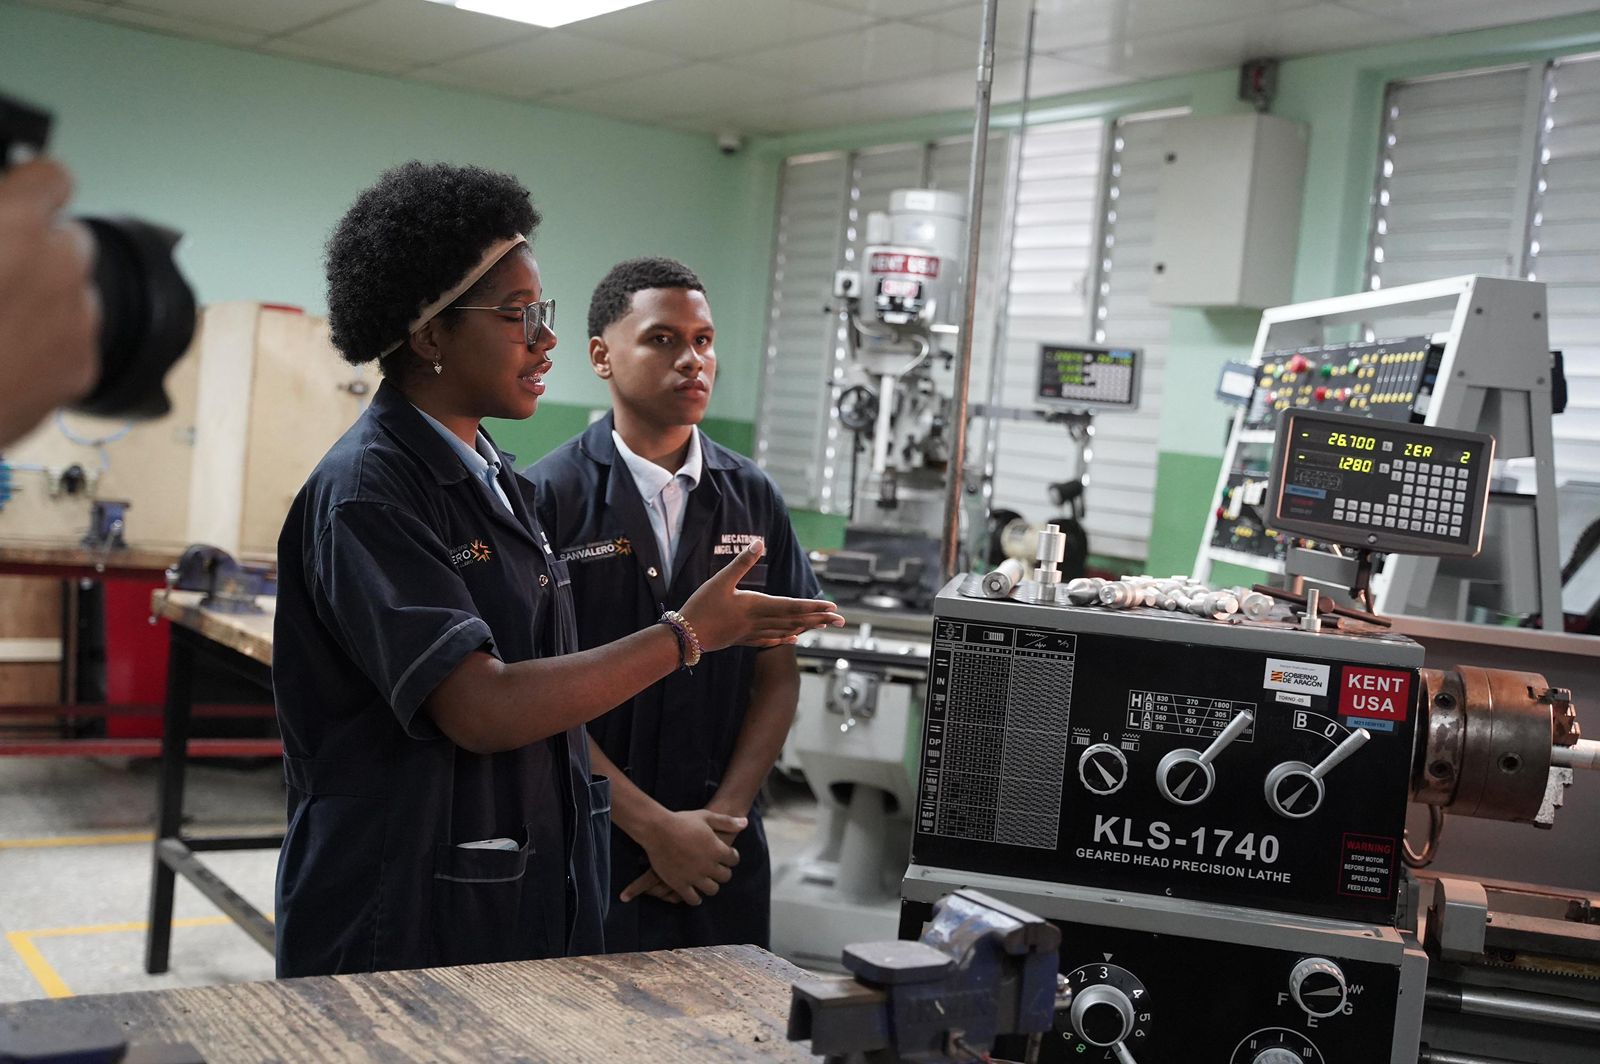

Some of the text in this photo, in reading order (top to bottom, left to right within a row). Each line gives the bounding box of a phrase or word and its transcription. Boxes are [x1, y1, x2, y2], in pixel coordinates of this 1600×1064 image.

[1404, 443, 1433, 457] ZER
[1460, 451, 1471, 464] 2
[560, 543, 615, 561] SANVALERO
[936, 677, 945, 686] IN
[1283, 671, 1318, 681] GOBIERNO
[1348, 673, 1404, 693] KENT
[1131, 693, 1142, 708] H
[1145, 693, 1153, 702] A
[1186, 698, 1199, 706] 370
[1214, 701, 1230, 709] 1800
[1352, 694, 1395, 713] USA
[1145, 701, 1152, 711] B
[1214, 711, 1227, 719] 305
[1129, 712, 1139, 726] L
[1143, 712, 1151, 720] A
[1184, 717, 1197, 725] 250
[1212, 720, 1228, 728] 1220
[1143, 721, 1151, 730] B
[1296, 712, 1307, 728] B
[929, 738, 941, 746] DP
[1093, 814, 1280, 864] KLS-1740
[1346, 841, 1391, 854] WARNING
[1076, 848, 1291, 883] GEARED HEAD PRECISION LATHE
[1351, 854, 1384, 864] STOP MOTOR
[1344, 863, 1389, 874] BEFORE SHIFTING
[1361, 886, 1382, 894] LEVERS
[1077, 970, 1088, 983] 2
[1099, 966, 1108, 979] 3
[1132, 989, 1144, 999] 4
[1277, 992, 1289, 1006] F
[1341, 1002, 1353, 1015] G
[1139, 1013, 1151, 1022] 5
[1307, 1015, 1318, 1028] E
[1076, 1043, 1086, 1053] 8
